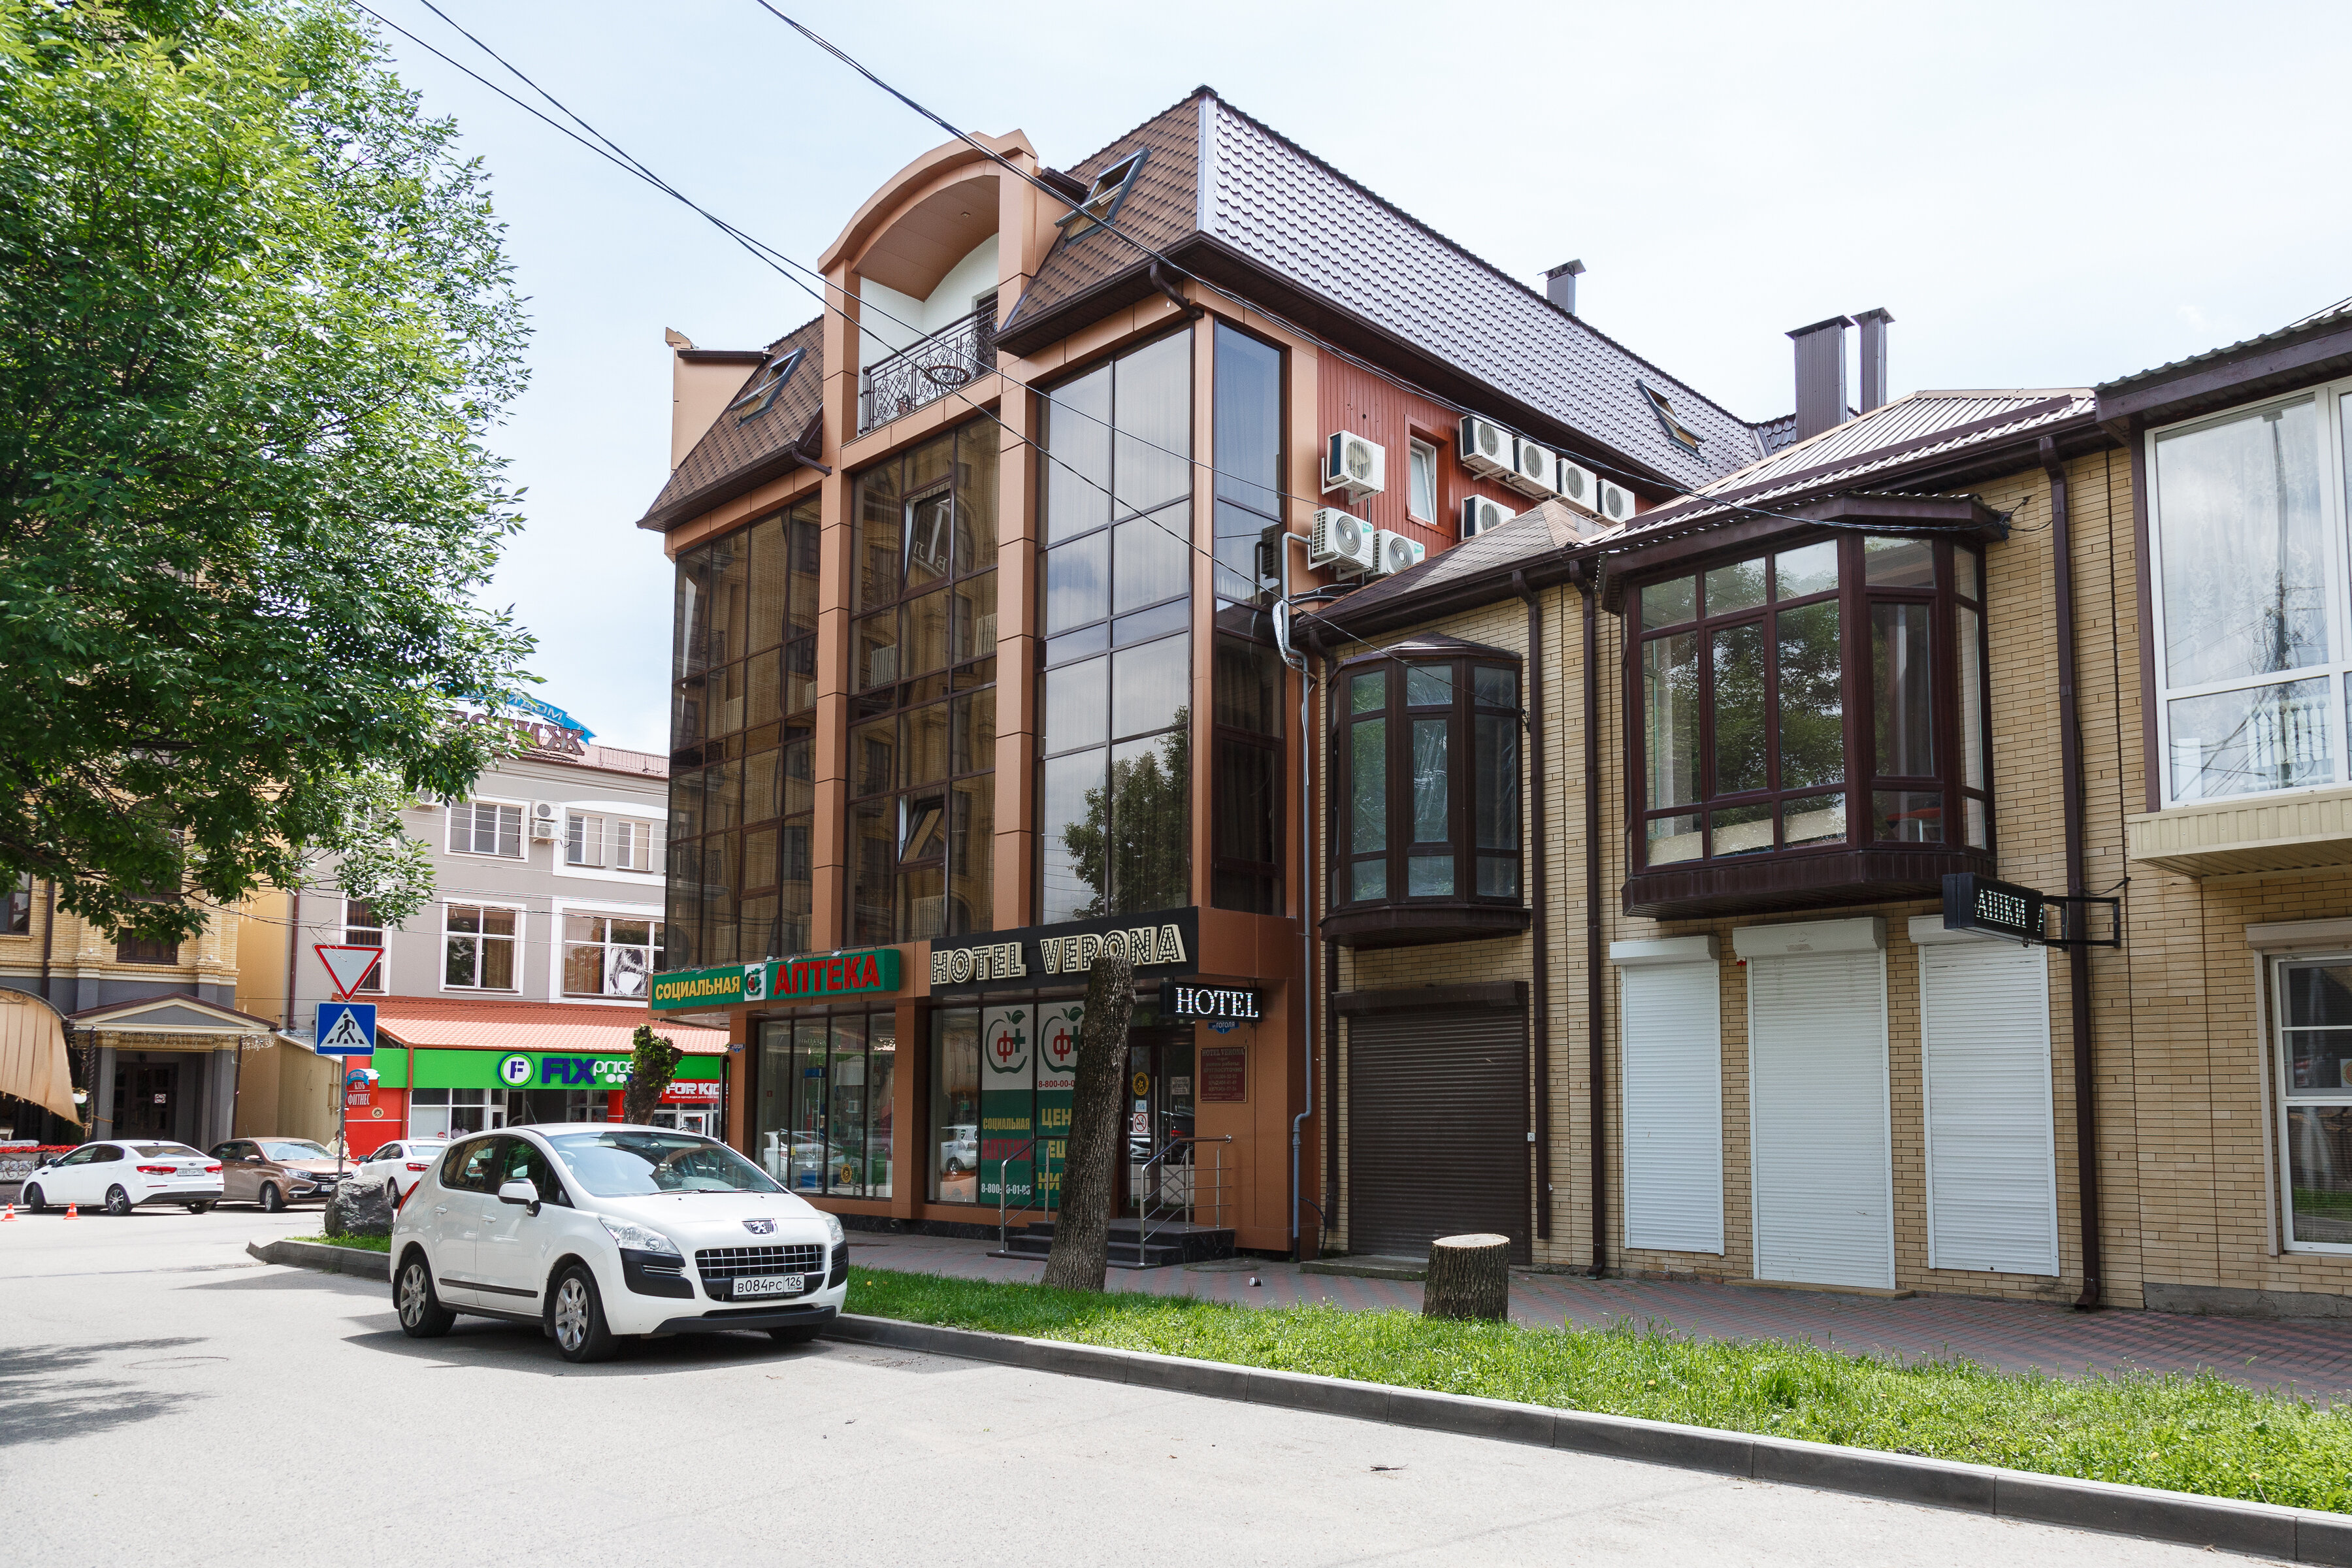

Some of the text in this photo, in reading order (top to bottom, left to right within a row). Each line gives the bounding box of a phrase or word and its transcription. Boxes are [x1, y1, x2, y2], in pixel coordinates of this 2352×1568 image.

[1975, 889, 2027, 928] АШКИ
[931, 924, 1187, 985] HOTEL VERONA
[655, 955, 881, 1001] СОЦИАЛЬНАЯ АПТЕКА
[1176, 987, 1258, 1018] HOTEL
[593, 1060, 634, 1077] price
[665, 1082, 728, 1096] FOR KID
[348, 1093, 370, 1105] ФИТНЕС
[983, 1118, 1030, 1132] СОЦИАЛЬНАЯ
[982, 1138, 1030, 1161] АПТЕКА
[1038, 1172, 1064, 1190] НИ
[738, 1277, 802, 1293] В084РС 126
